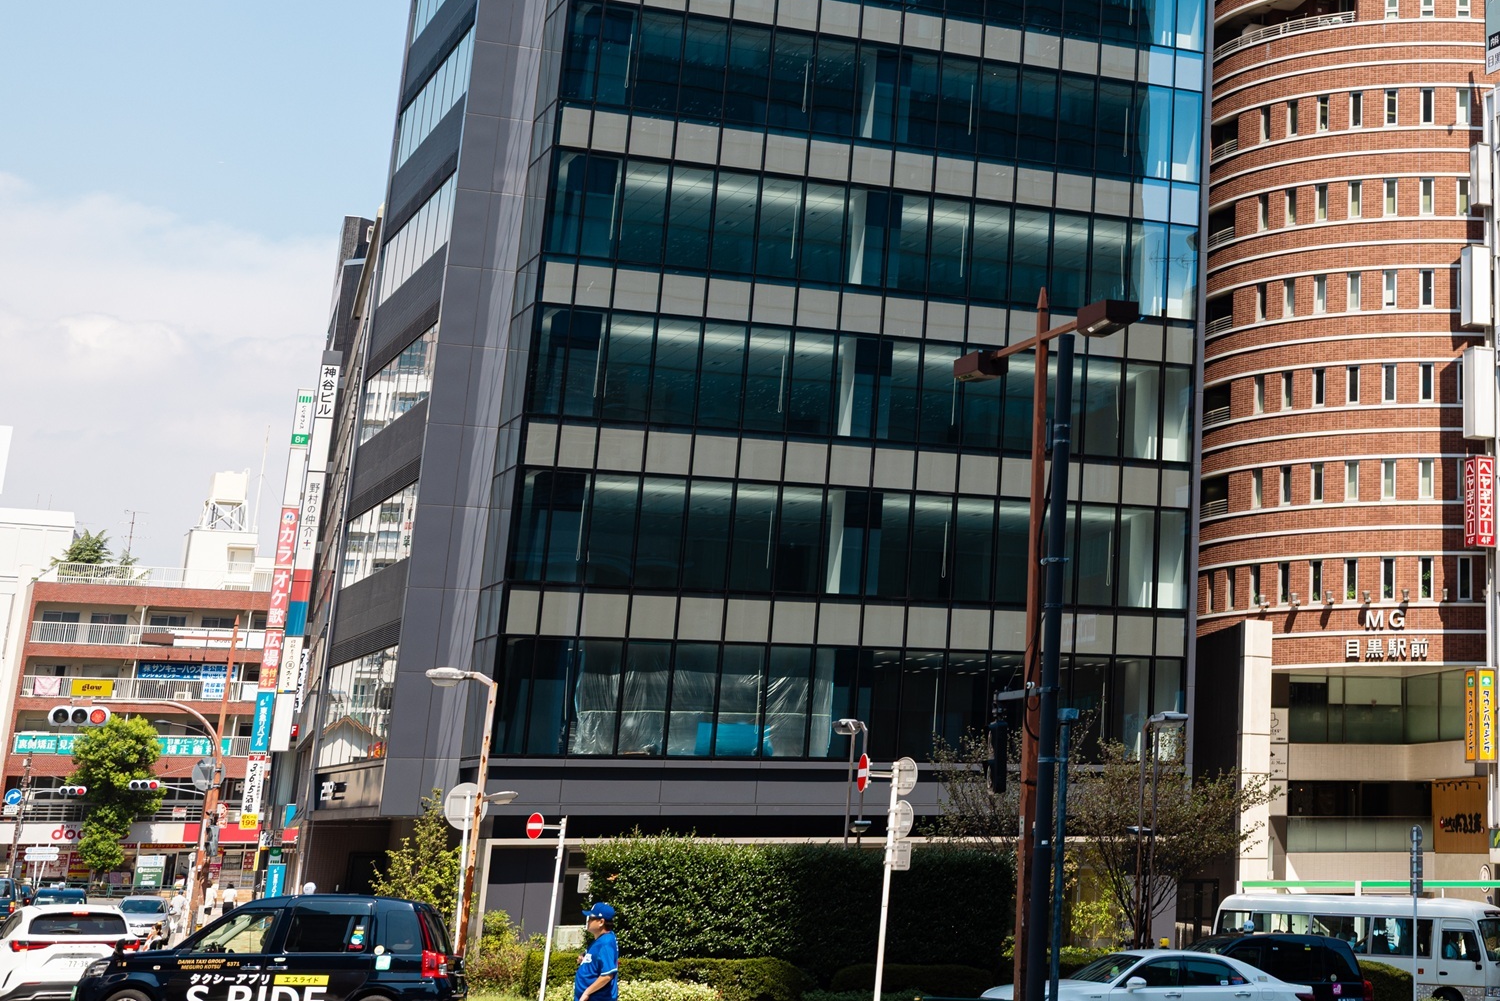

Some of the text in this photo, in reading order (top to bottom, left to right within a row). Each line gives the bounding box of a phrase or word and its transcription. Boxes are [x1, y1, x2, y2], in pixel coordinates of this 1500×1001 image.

[318, 366, 337, 415] 神谷ビル
[294, 435, 305, 443] 8F
[1481, 536, 1491, 544] 4F
[1365, 609, 1405, 629] MG
[1345, 637, 1429, 659] 目黒駅前
[82, 683, 102, 691] glow
[260, 678, 275, 687] 4F
[1482, 689, 1491, 754] タウンハウジング
[190, 973, 271, 985] タクシーアプリ
